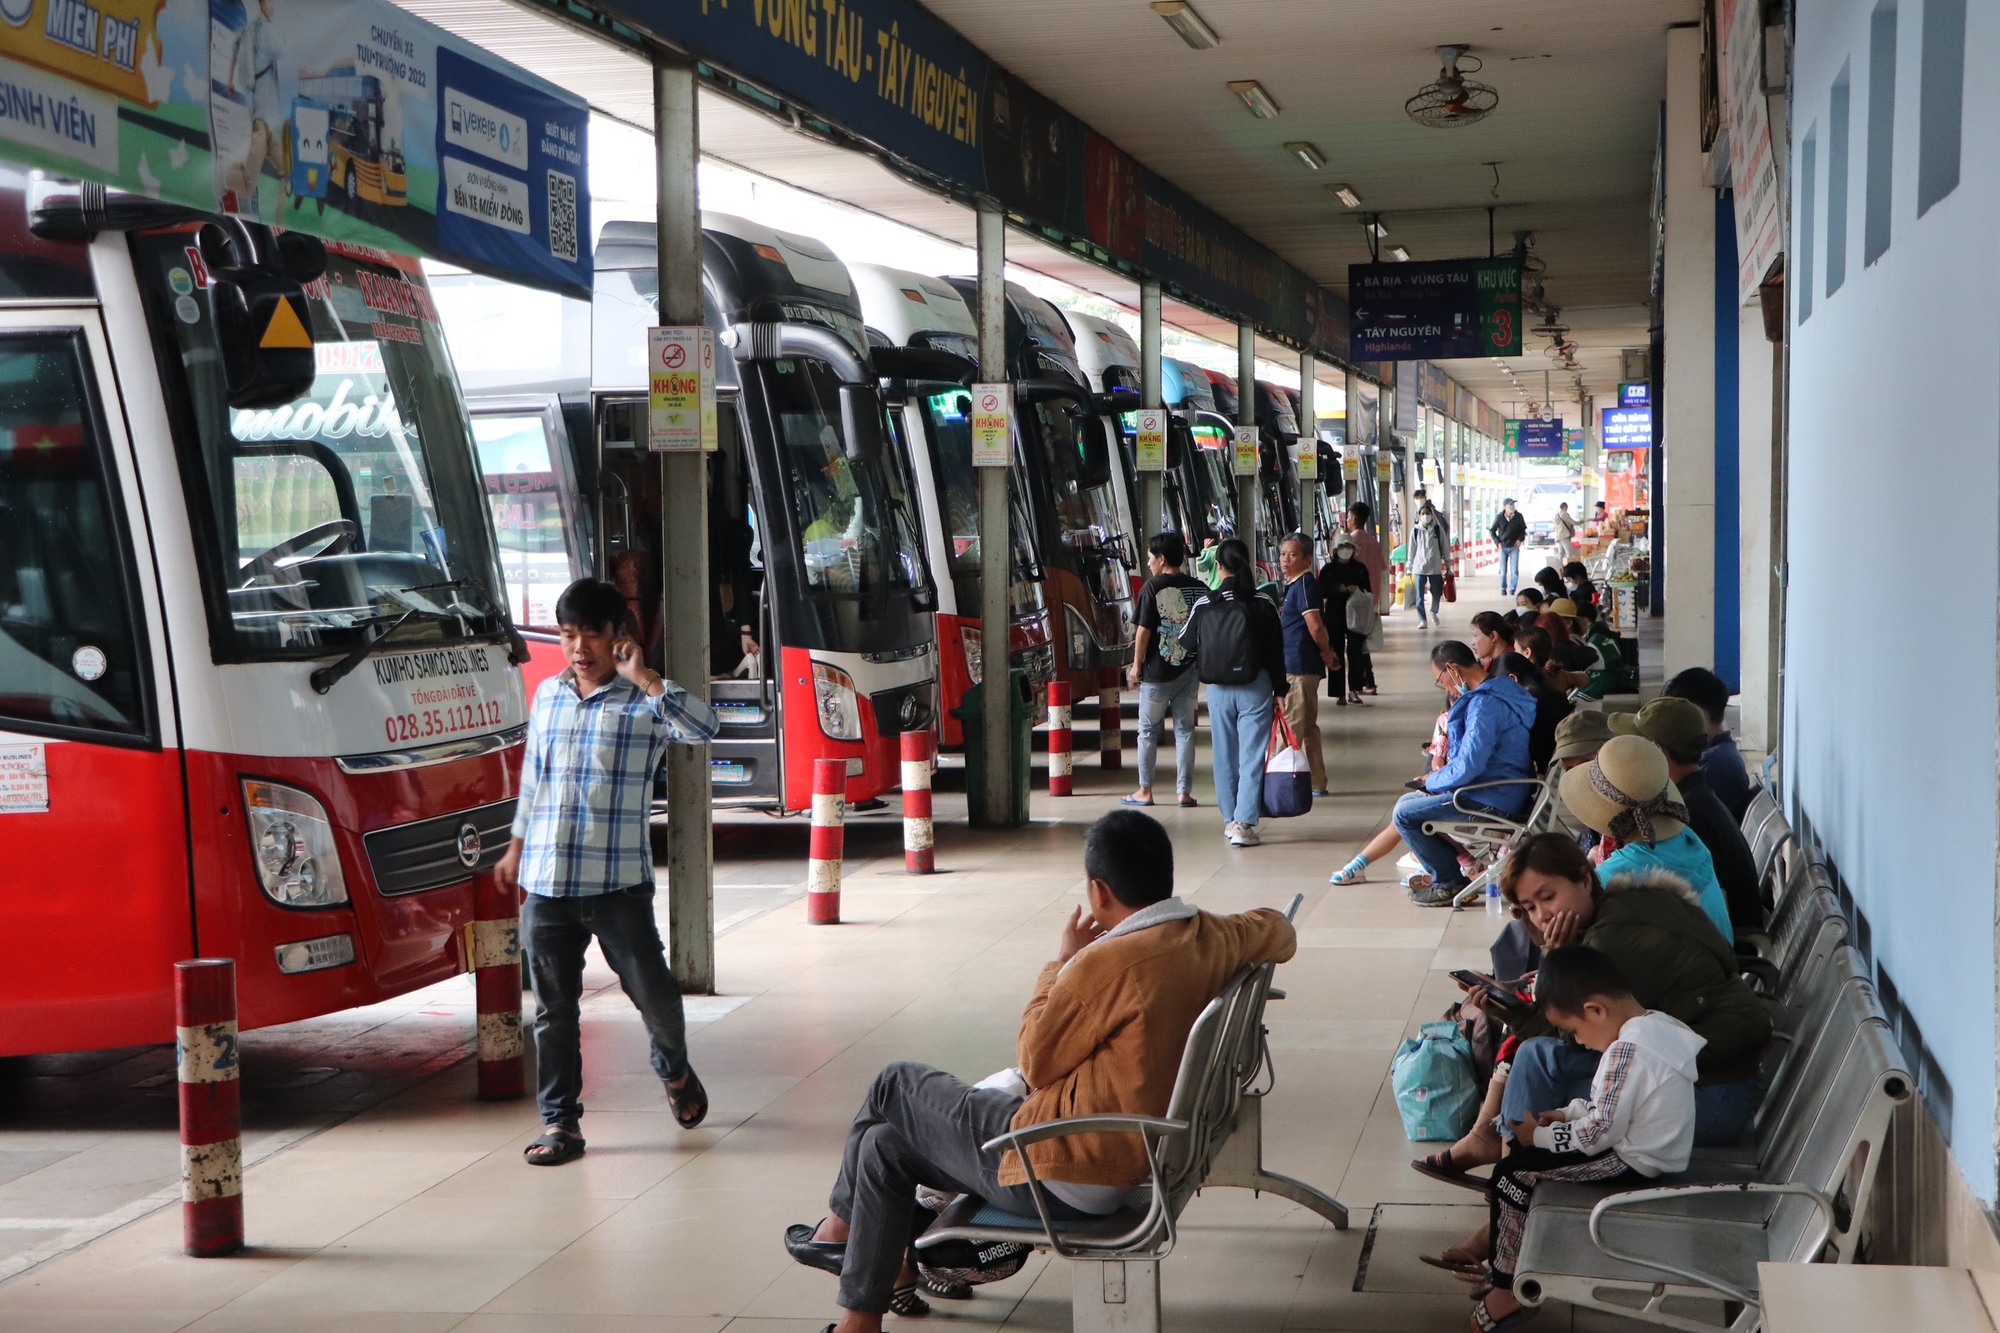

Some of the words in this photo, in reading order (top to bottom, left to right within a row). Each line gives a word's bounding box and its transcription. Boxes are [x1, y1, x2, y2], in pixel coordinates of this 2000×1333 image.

[102, 15, 139, 73] PHÍ
[371, 24, 403, 54] CHUYẾN
[405, 39, 414, 58] XE
[408, 66, 426, 88] 2022
[877, 20, 912, 108] TÂY
[911, 53, 978, 148] NGUYÊN
[0, 81, 46, 130] SINH
[48, 96, 96, 148] VIÊN
[454, 184, 468, 208] BẾN
[468, 194, 478, 213] XE
[500, 202, 524, 226] ĐÔNG
[1364, 274, 1380, 287] BÀ
[1383, 276, 1402, 288] RỊA
[1410, 273, 1444, 285] VŨNG
[1447, 272, 1469, 283] TÀU
[1477, 270, 1497, 289] KHU
[1499, 266, 1517, 293] VỰC
[1365, 326, 1387, 338] TÂY
[1389, 324, 1441, 338] NGUYÊN
[1492, 309, 1513, 347] 3
[1365, 342, 1412, 353] Highlands
[654, 373, 696, 396] KHÔNG
[976, 414, 1005, 430] KHÔNG
[1138, 433, 1161, 443] KHÔNG
[1507, 435, 1515, 449] 4
[373, 655, 414, 685] KUMHO
[414, 650, 449, 679] SAMCO
[411, 686, 436, 705] TỔNG
[385, 700, 501, 743] 028.35.112.112
[835, 799, 845, 819] 3
[504, 927, 520, 956] 3
[213, 1034, 237, 1070] 2
